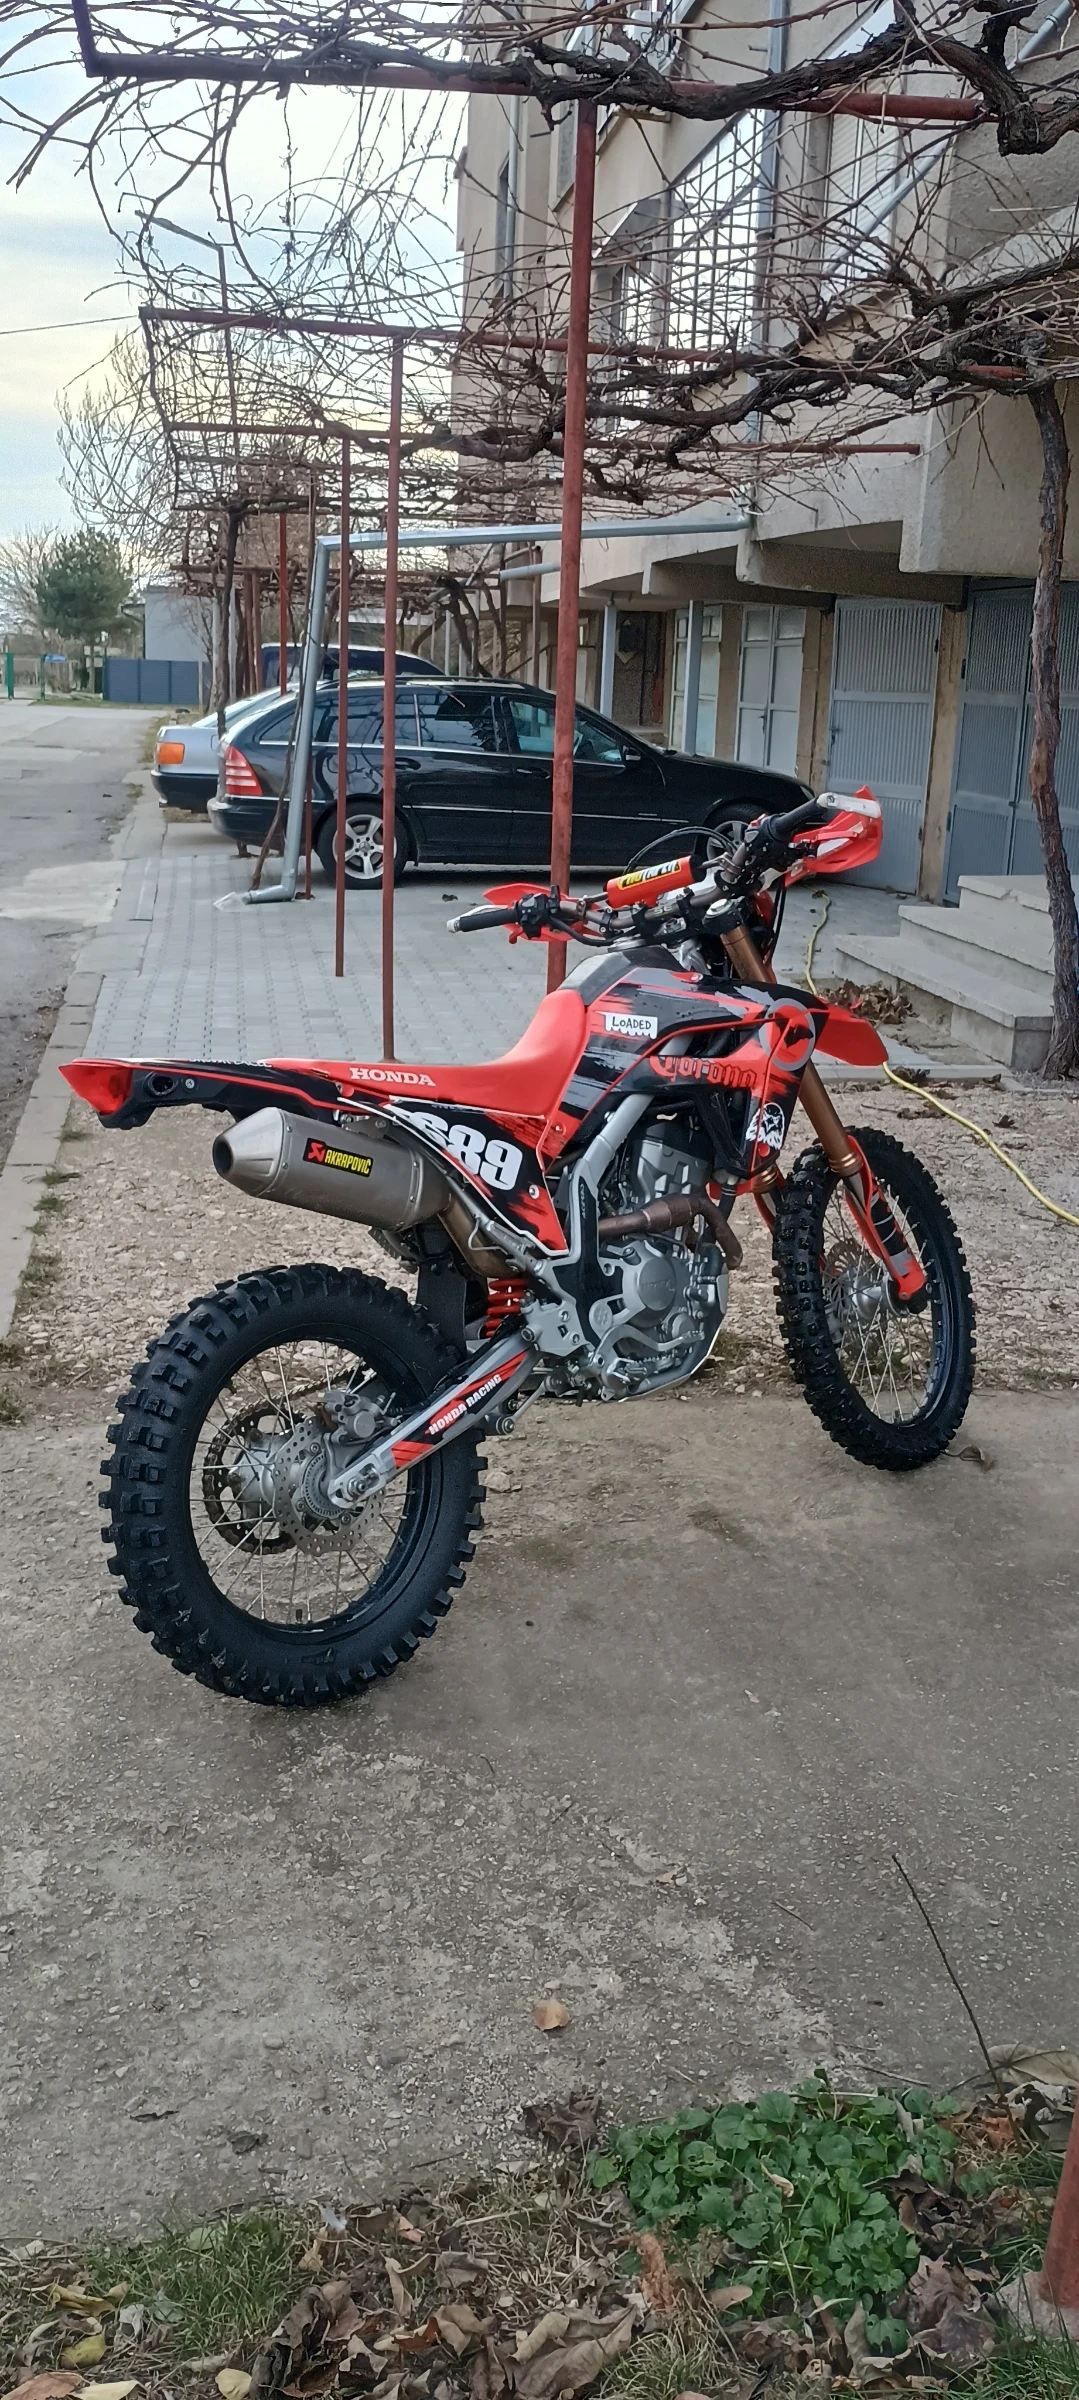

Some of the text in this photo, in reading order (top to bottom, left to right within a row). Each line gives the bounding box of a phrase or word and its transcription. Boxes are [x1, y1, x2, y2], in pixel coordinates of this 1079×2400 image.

[349, 1067, 436, 1087] HONDA
[428, 1374, 502, 1435] HONDA RACING
